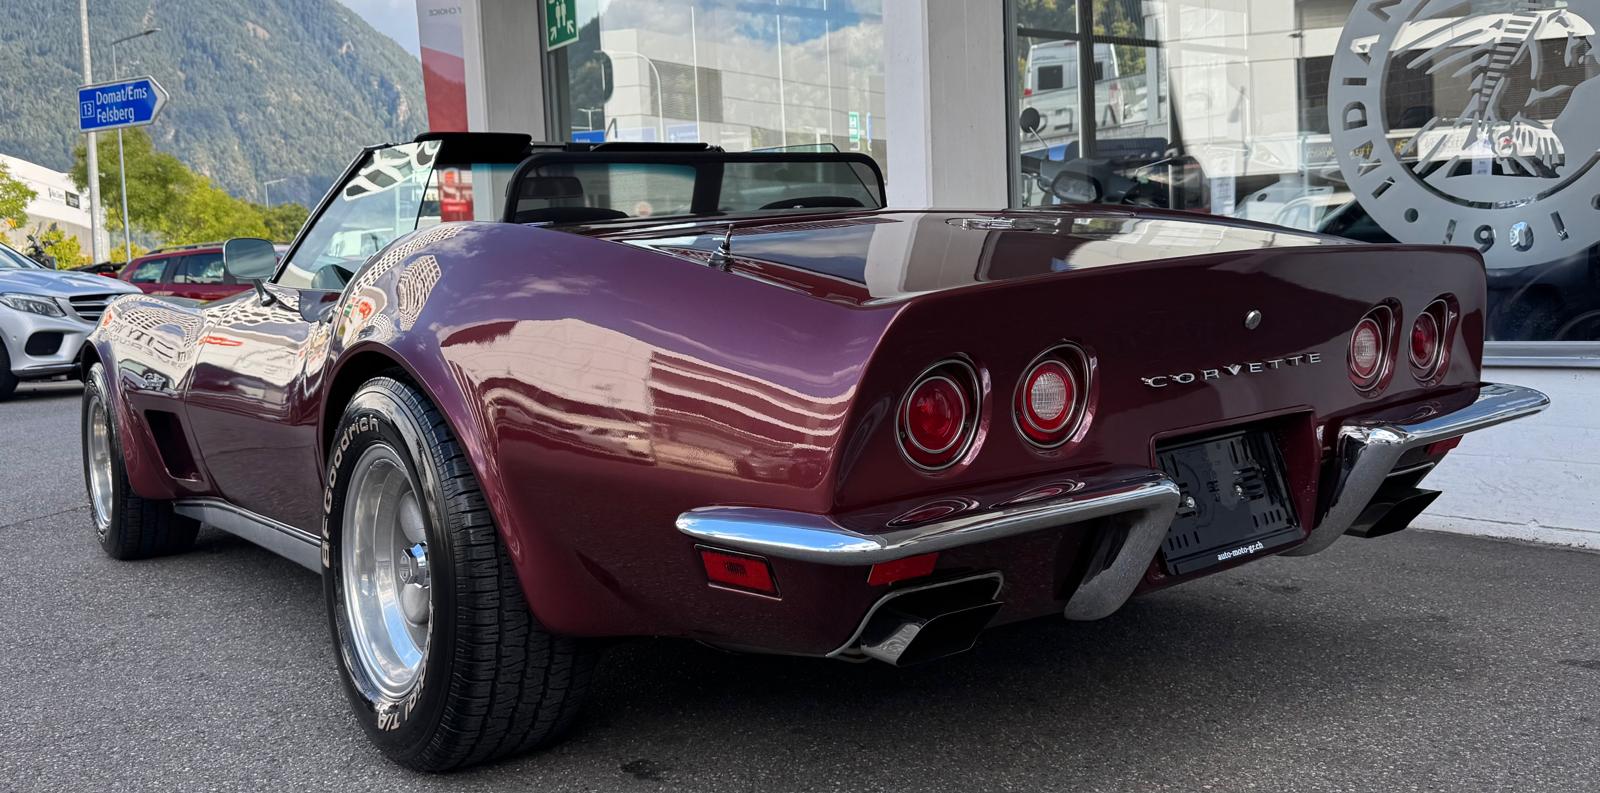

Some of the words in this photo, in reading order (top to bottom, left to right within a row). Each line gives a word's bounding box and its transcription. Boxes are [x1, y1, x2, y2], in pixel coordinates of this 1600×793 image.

[95, 86, 148, 106] Domat/Ems
[83, 103, 92, 116] 13
[96, 106, 135, 123] Felsberg
[1443, 210, 1570, 254] 1901
[1145, 353, 1322, 388] CORVETTE
[321, 413, 380, 569] BFGoodrich
[1217, 540, 1264, 561] auto-moto-gr.ch
[377, 711, 401, 731] T/A
